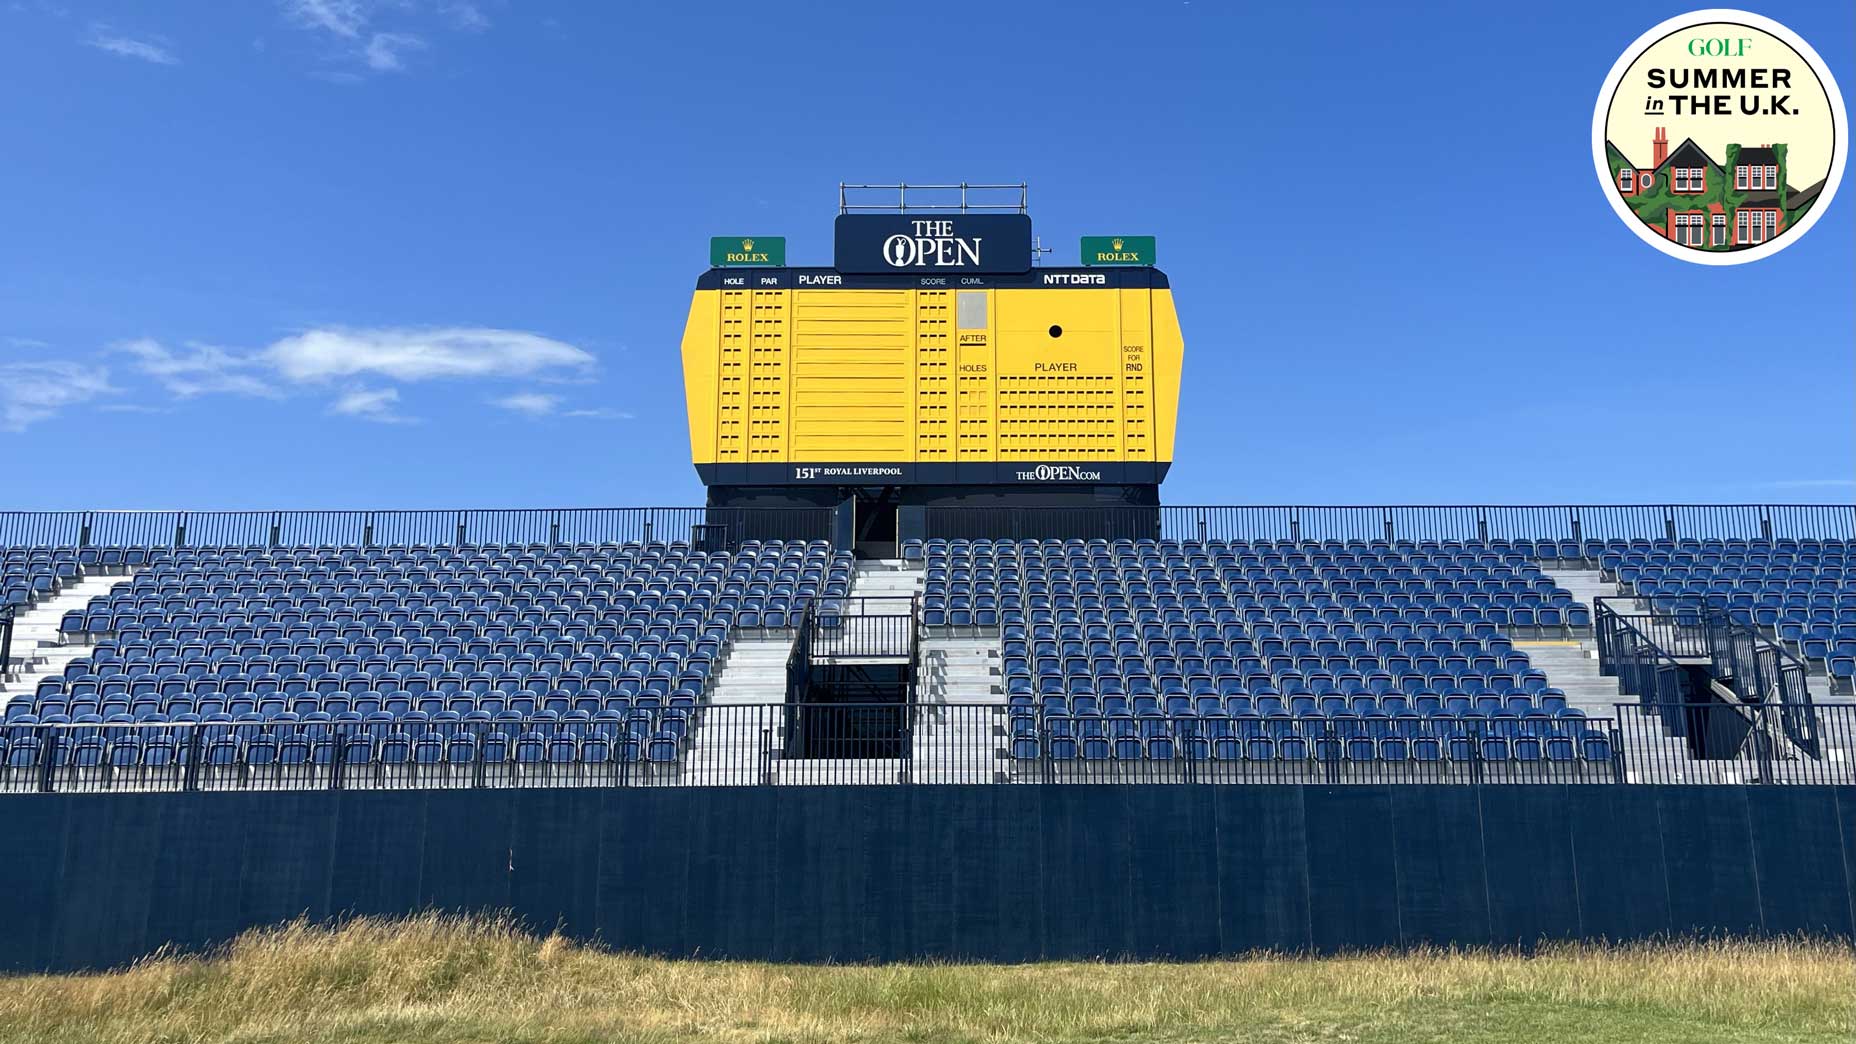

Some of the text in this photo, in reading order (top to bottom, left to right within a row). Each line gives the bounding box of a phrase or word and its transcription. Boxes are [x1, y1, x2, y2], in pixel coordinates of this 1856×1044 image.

[912, 220, 954, 238] THE
[883, 234, 982, 267] OPEN
[727, 253, 769, 262] ROLEX
[1097, 252, 1139, 262] ROLEX
[799, 275, 842, 285] PLAYER
[920, 278, 946, 286] SCORE
[1044, 274, 1070, 284] NTT
[959, 364, 987, 372] HOLES
[1035, 363, 1077, 372] PLAYER
